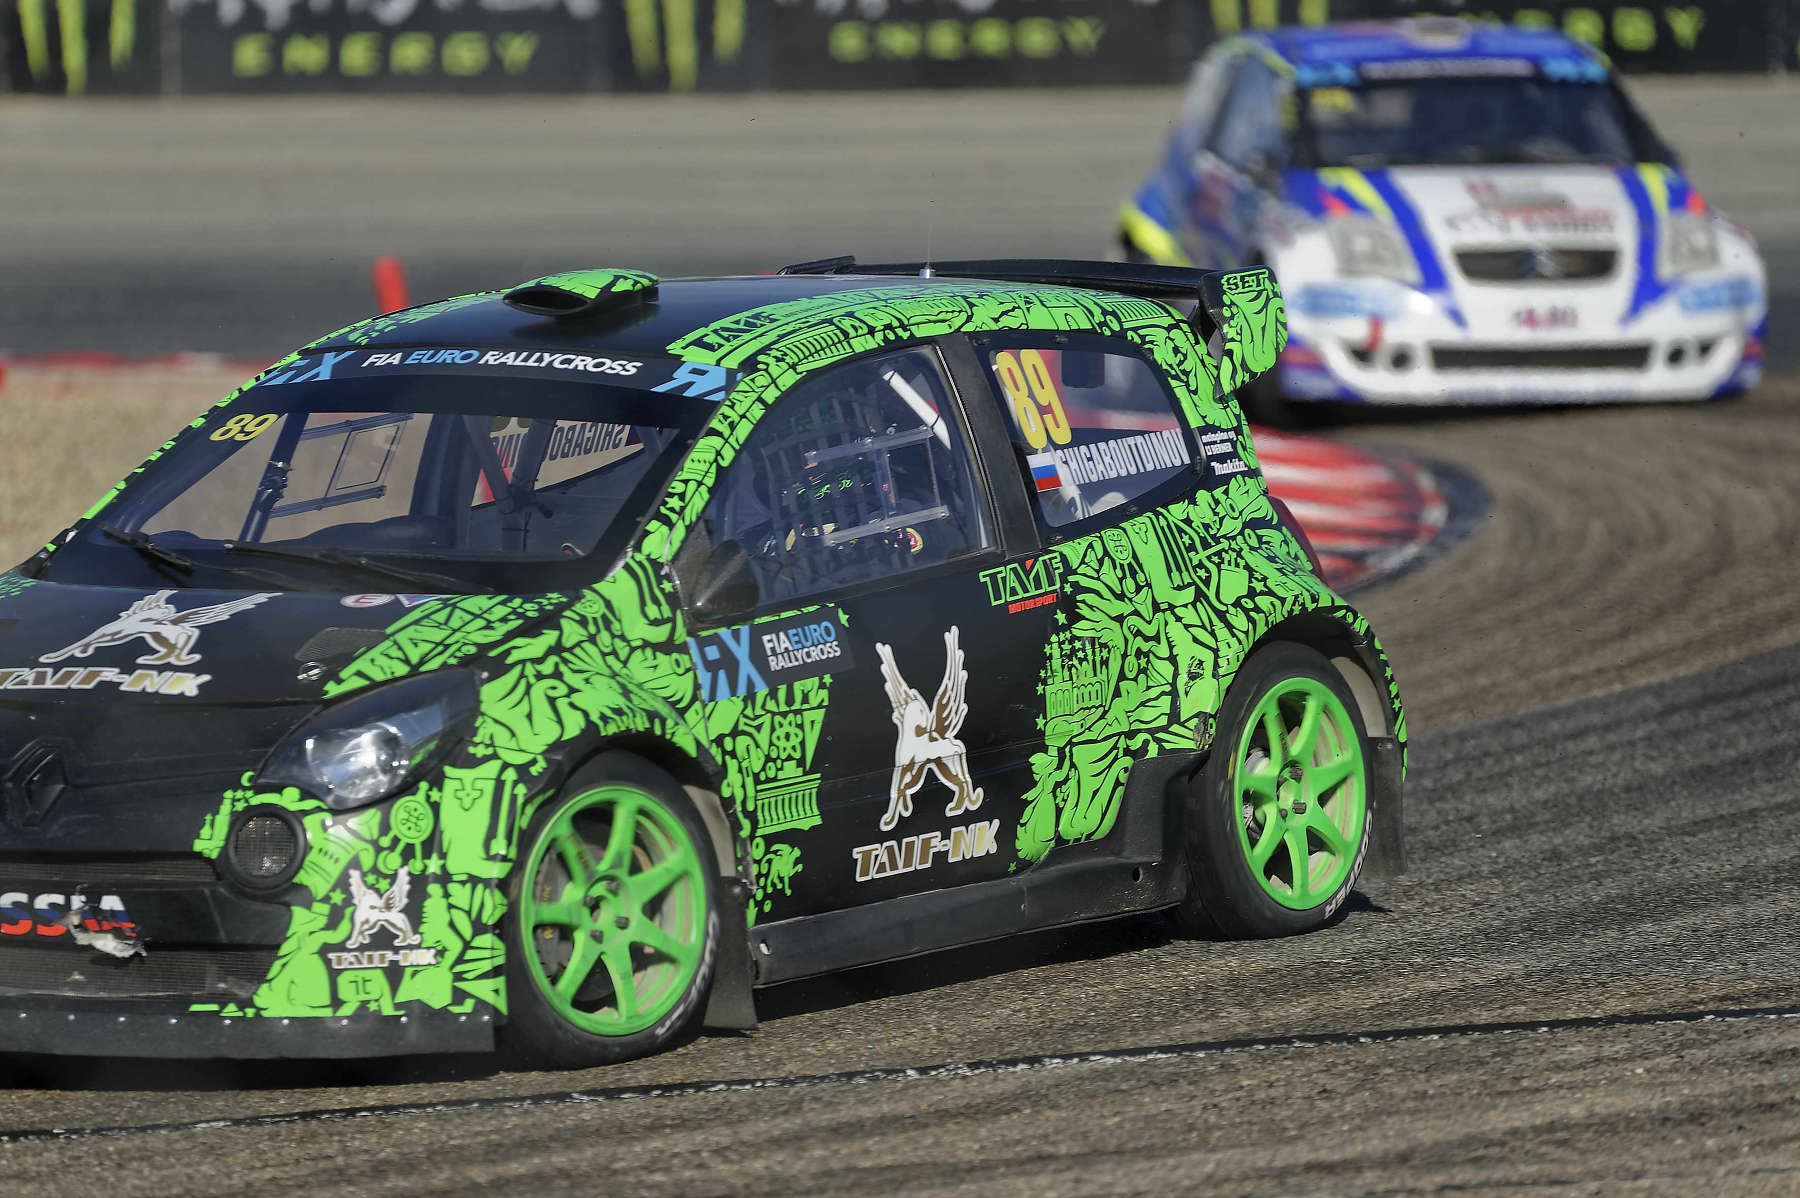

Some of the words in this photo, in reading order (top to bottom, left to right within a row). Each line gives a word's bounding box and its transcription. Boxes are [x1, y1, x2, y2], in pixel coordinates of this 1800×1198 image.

[232, 31, 540, 78] ENERGY
[828, 16, 1105, 62] ENERGY
[360, 353, 403, 368] FIA
[404, 349, 479, 366] EURO
[478, 350, 643, 376] RALLYCROSS
[996, 349, 1072, 449] 89
[209, 414, 280, 441] 89
[1055, 428, 1191, 484] SHIGABOUTDINOV
[768, 641, 841, 671] RALLYCROSS
[0, 668, 212, 697] TAIF-NK
[853, 819, 1000, 882] TAIF-NK
